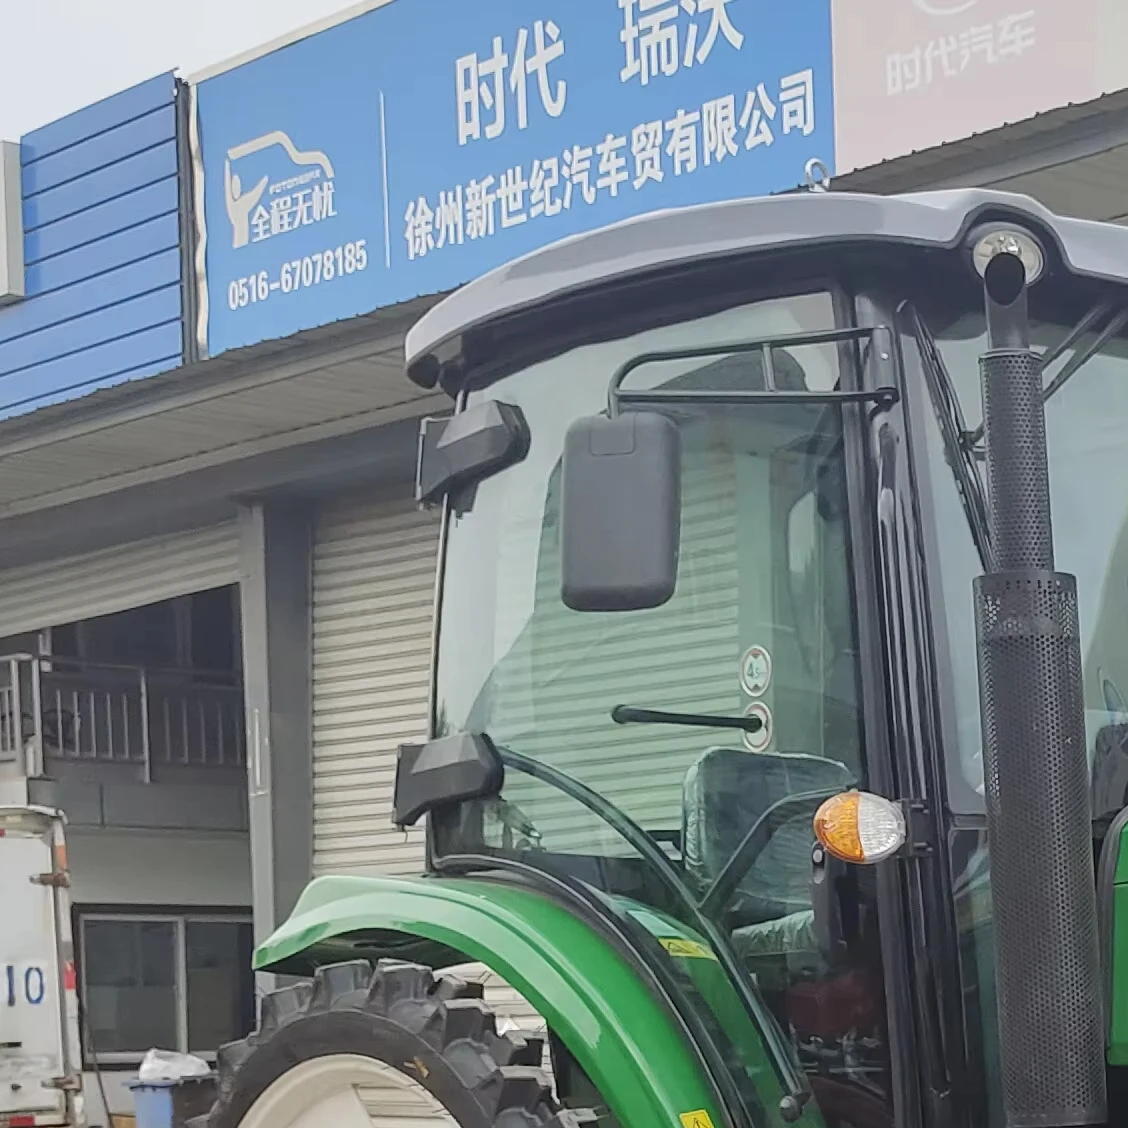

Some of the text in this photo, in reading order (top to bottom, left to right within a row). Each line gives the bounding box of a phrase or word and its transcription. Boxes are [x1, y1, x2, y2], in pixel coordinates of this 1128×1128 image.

[456, 19, 567, 146] 时代
[886, 9, 1037, 96] 时代汽车
[404, 68, 816, 260] 徐州新世纪汽车贸有限公司
[229, 239, 368, 311] 0516-67078185
[6, 965, 44, 1007] 10
